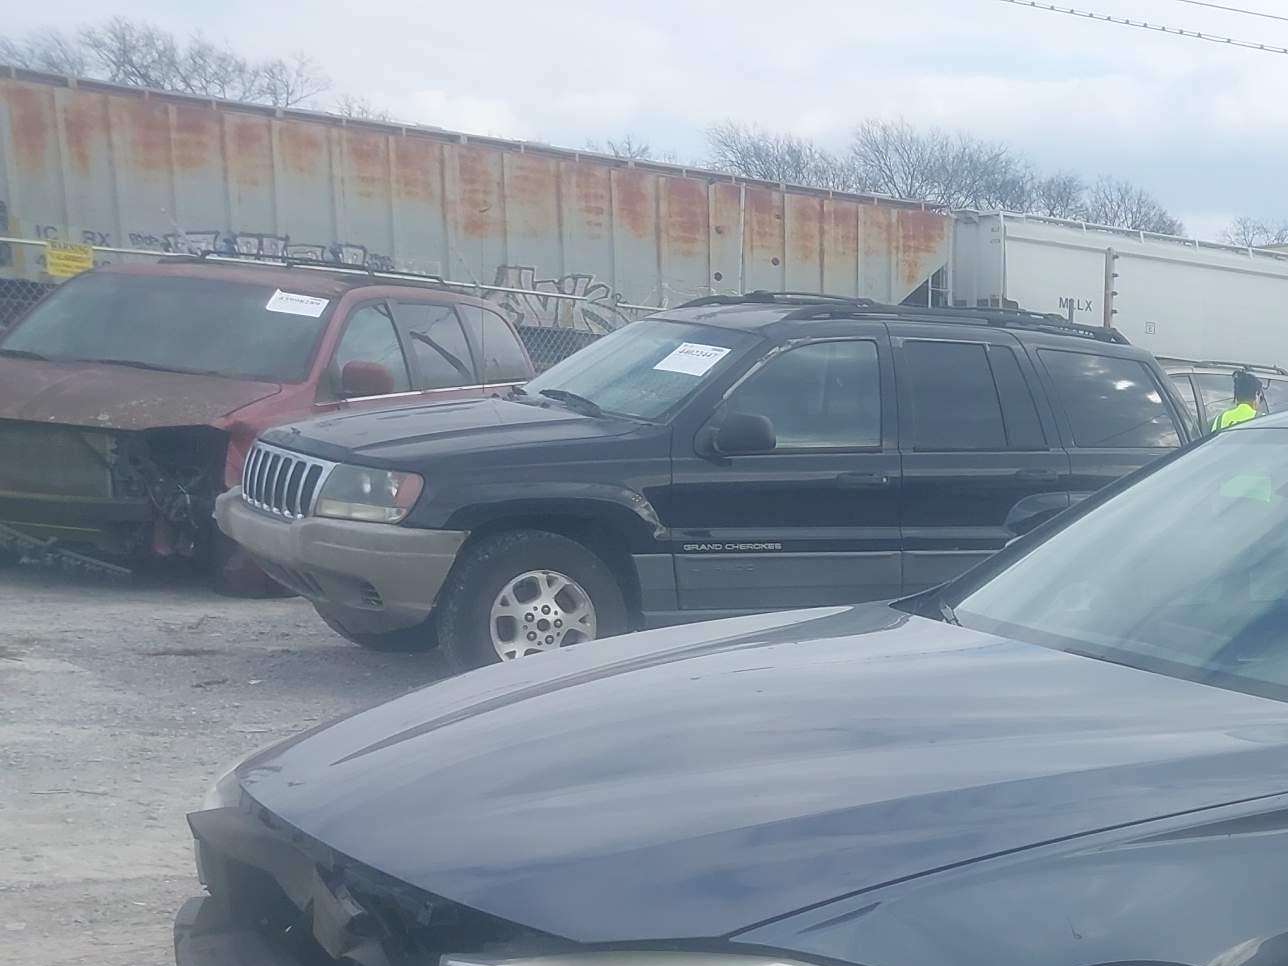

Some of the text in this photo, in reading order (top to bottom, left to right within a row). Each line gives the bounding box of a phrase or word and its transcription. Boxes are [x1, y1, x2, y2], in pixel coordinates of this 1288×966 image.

[1058, 296, 1093, 312] MLX
[683, 542, 782, 551] GRAND CHEROKEE
